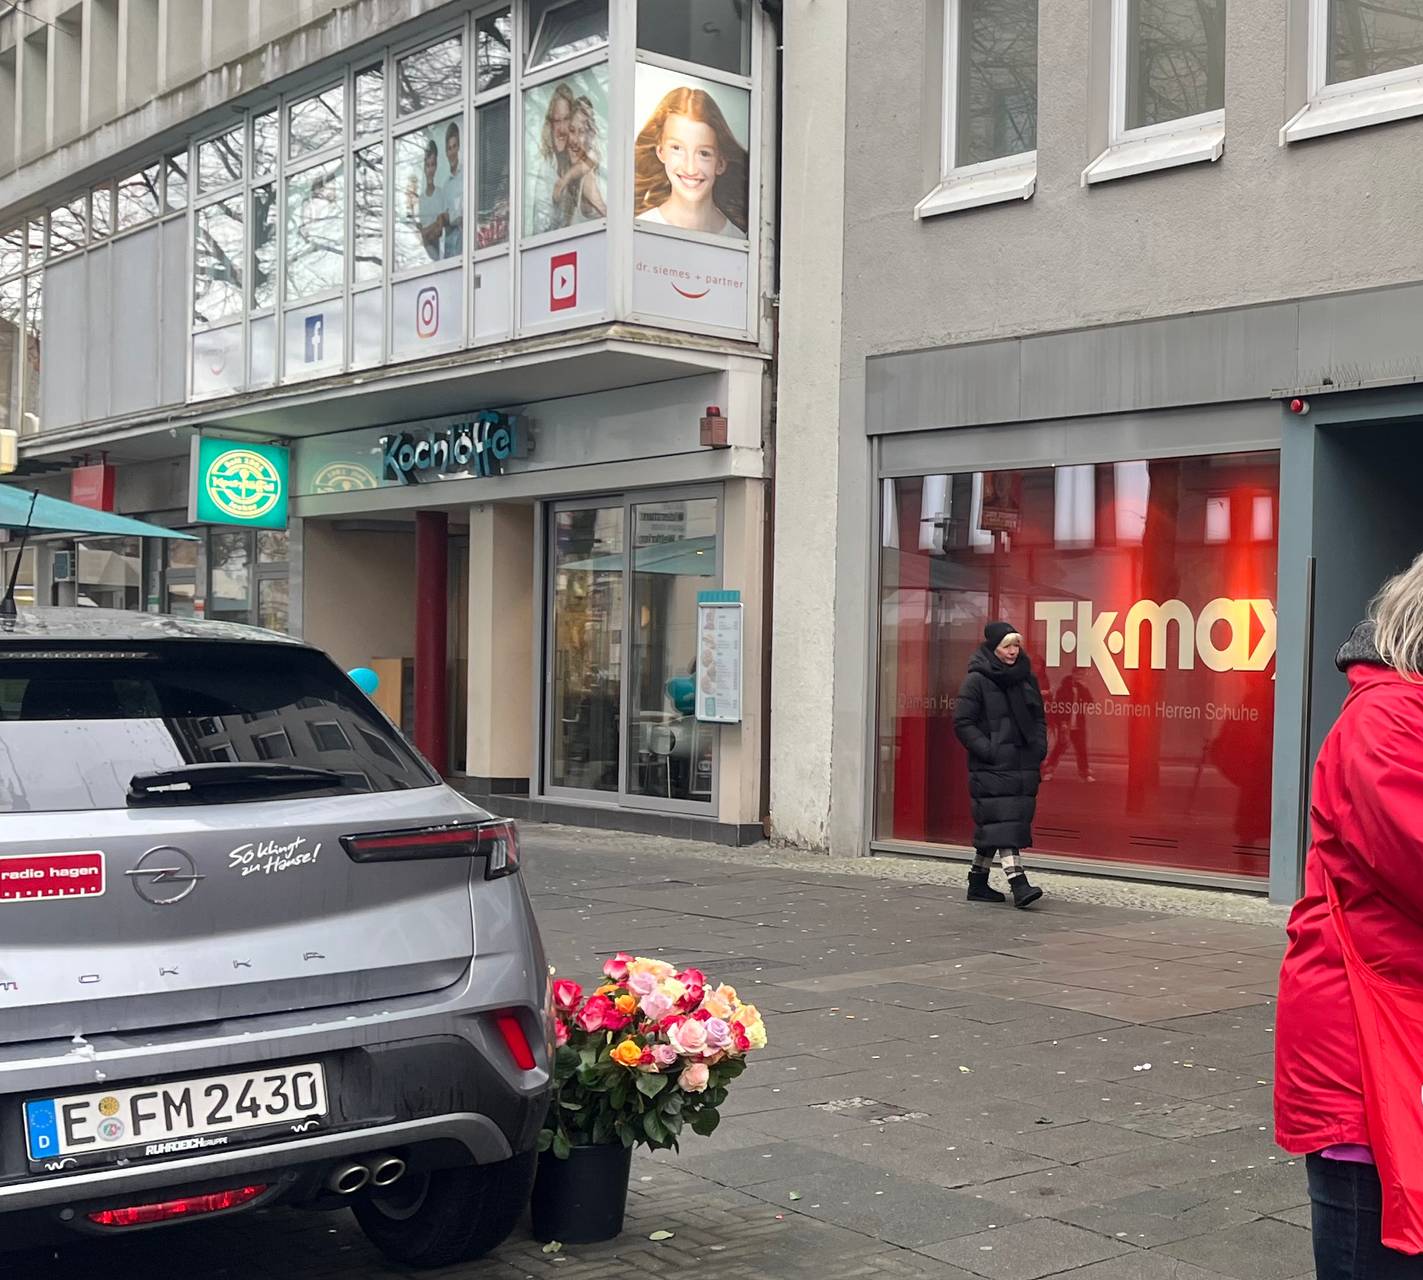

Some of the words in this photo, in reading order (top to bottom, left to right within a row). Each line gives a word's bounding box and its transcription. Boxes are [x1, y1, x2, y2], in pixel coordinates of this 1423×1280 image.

[653, 264, 691, 280] siemes
[705, 274, 744, 289] partner
[1043, 699, 1102, 715] cessoires
[1104, 699, 1151, 718] Damen
[1155, 702, 1201, 720] Herren
[1205, 703, 1259, 722] Schuhe
[228, 843, 255, 868] So
[257, 836, 307, 859] klingt
[241, 863, 261, 876] zu
[263, 843, 322, 874] Hause!
[1, 868, 45, 880] radio
[49, 866, 99, 878] hagen
[61, 1101, 96, 1147] E
[129, 1087, 194, 1136] FM
[204, 1072, 318, 1125] 2430
[38, 1134, 50, 1149] D
